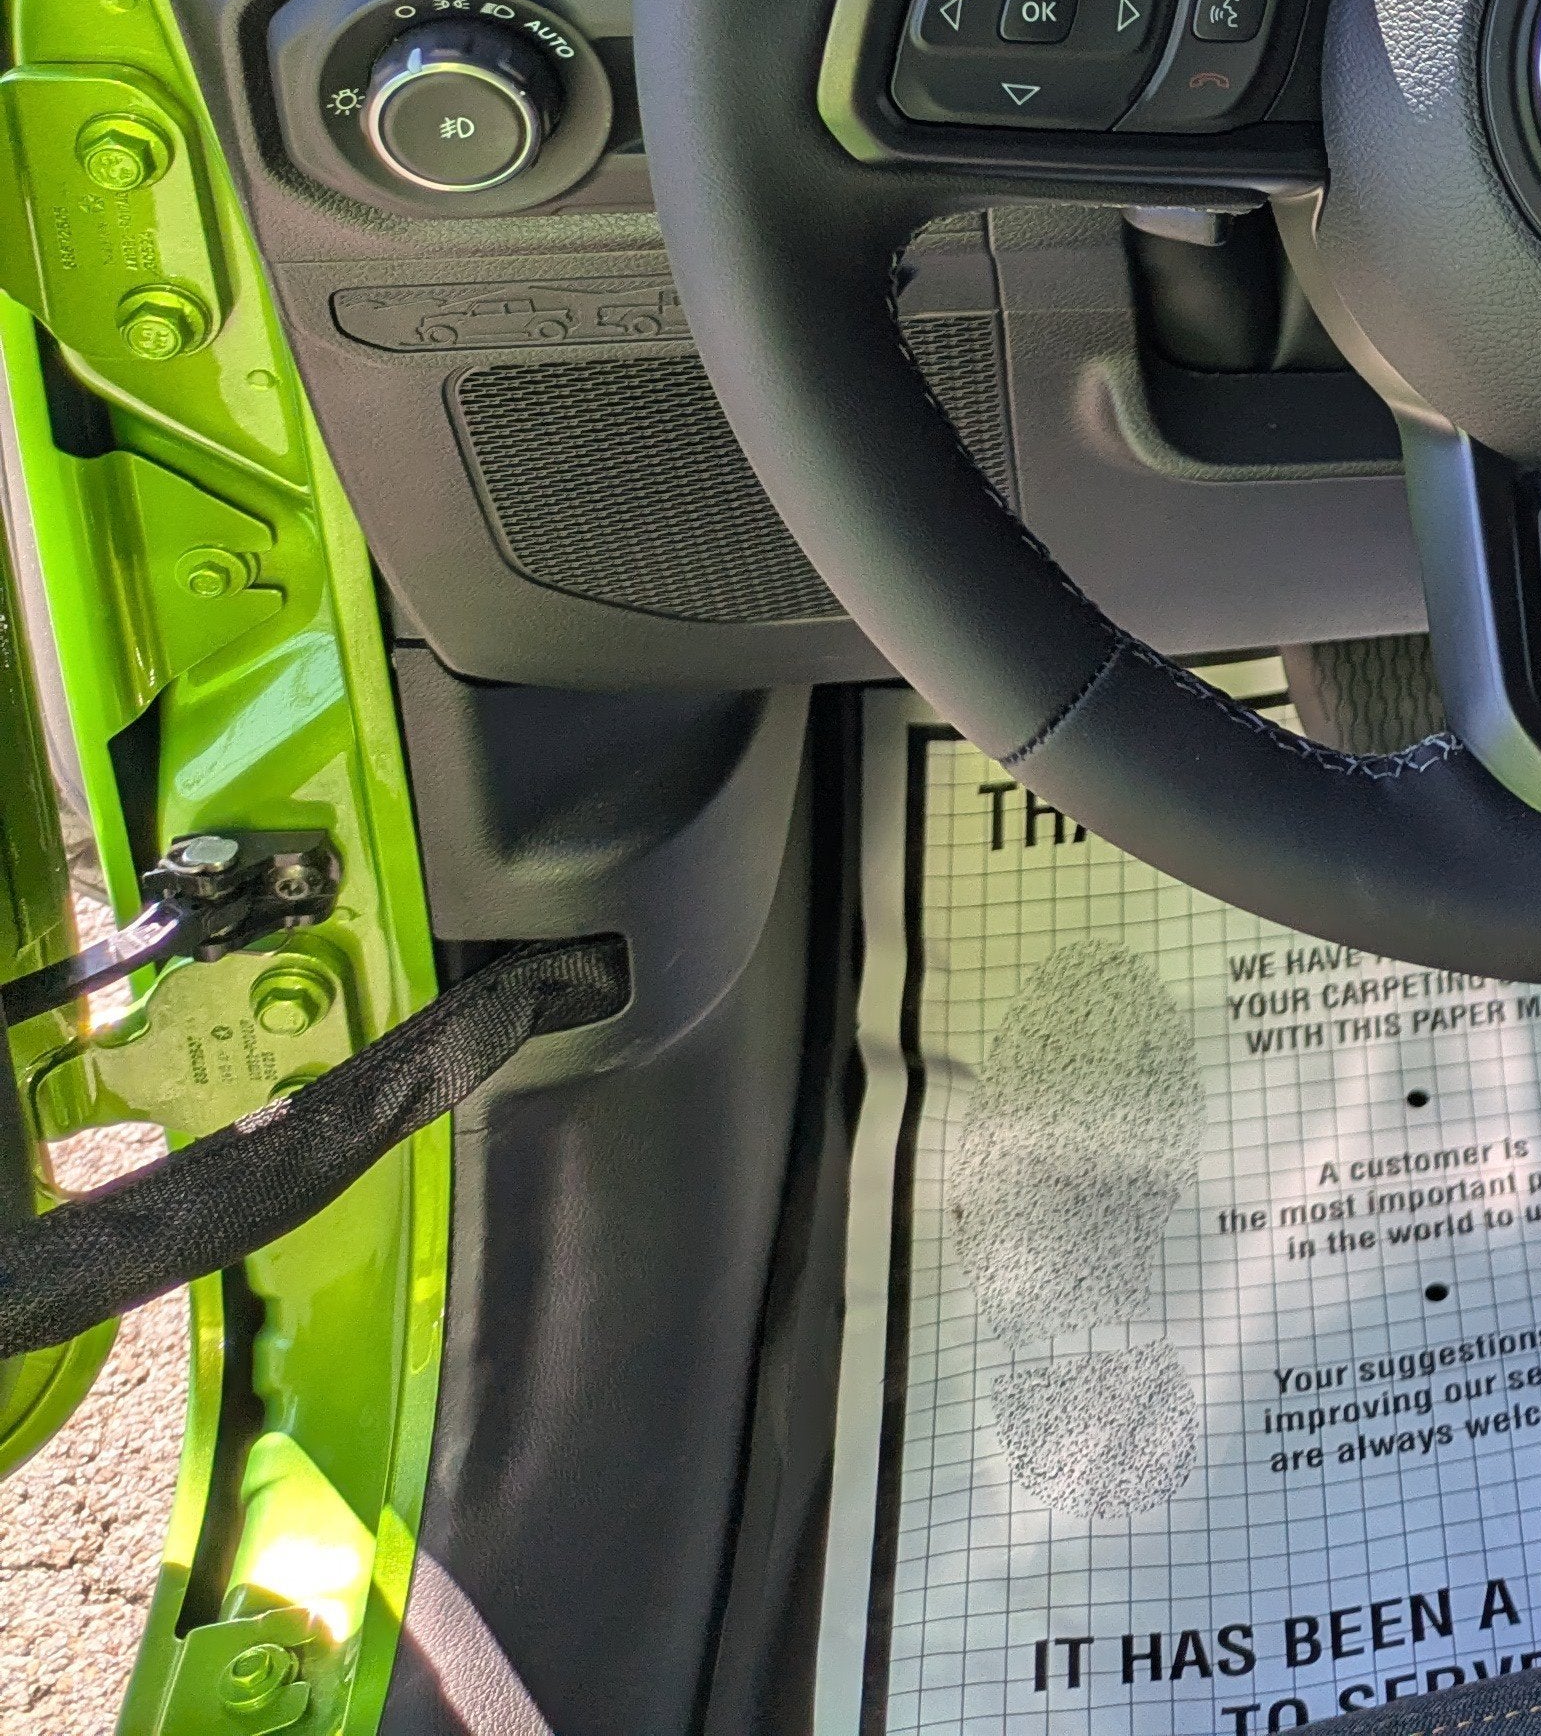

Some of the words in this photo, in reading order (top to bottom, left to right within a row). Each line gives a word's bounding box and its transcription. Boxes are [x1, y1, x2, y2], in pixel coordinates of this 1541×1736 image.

[1022, 2, 1057, 23] OK
[524, 20, 574, 59] AUTO
[1246, 1024, 1325, 1054] WITH
[1337, 1014, 1401, 1044] THIS
[1413, 1000, 1506, 1034] PAPER
[1319, 1162, 1340, 1185] A
[1353, 1142, 1492, 1178] customer
[1503, 1138, 1528, 1159] is
[1218, 1207, 1267, 1234] the
[1280, 1195, 1355, 1226] most
[1369, 1174, 1518, 1213] important
[1264, 1387, 1432, 1434] improving
[1444, 1373, 1498, 1403] our
[1274, 1364, 1348, 1394] Your
[1270, 1446, 1323, 1473] are
[1337, 1424, 1453, 1463] always
[1034, 1636, 1094, 1692] IT
[1121, 1622, 1256, 1684] HAS
[1284, 1588, 1453, 1665] BEEN
[1480, 1578, 1520, 1629] A
